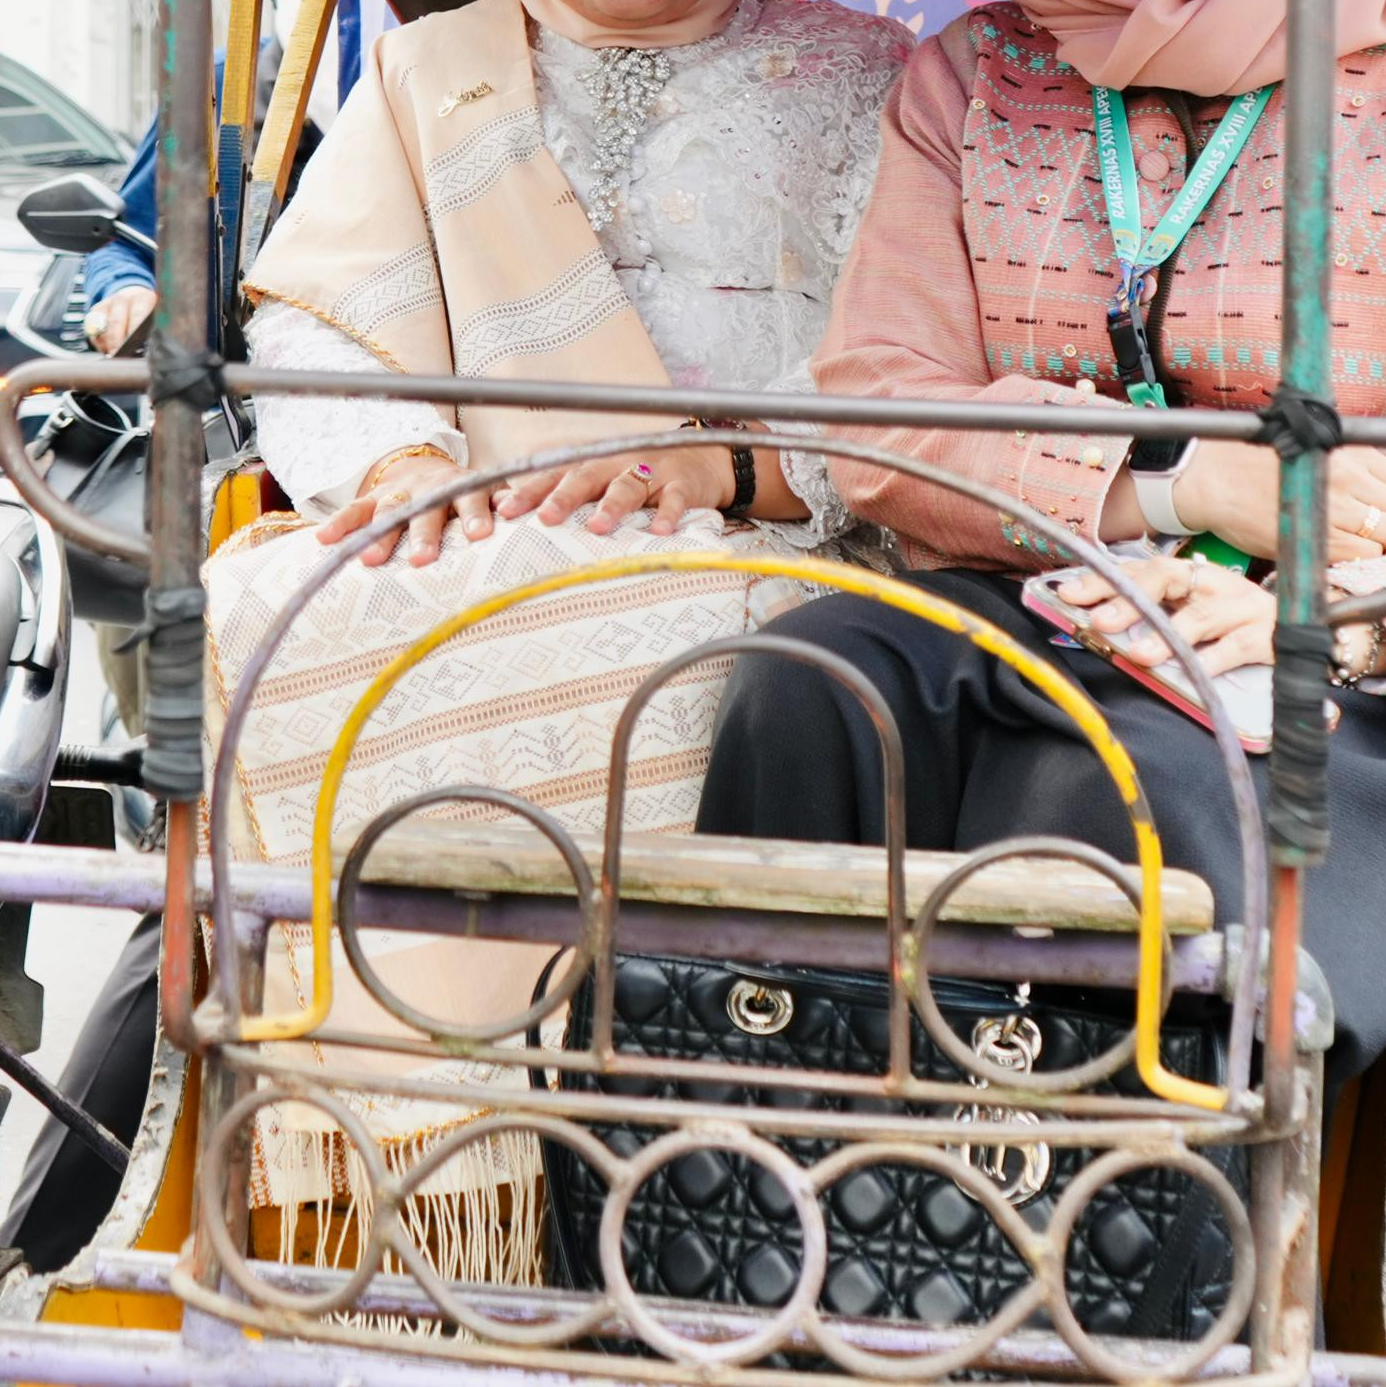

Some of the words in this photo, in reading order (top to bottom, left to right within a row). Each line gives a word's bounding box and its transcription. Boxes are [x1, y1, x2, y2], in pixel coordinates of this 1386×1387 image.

[1099, 116, 1115, 147] XVIII
[1102, 147, 1126, 219] RAKERNAS
[1169, 149, 1225, 224] RAKERNAS
[1217, 113, 1248, 149] XVIII
